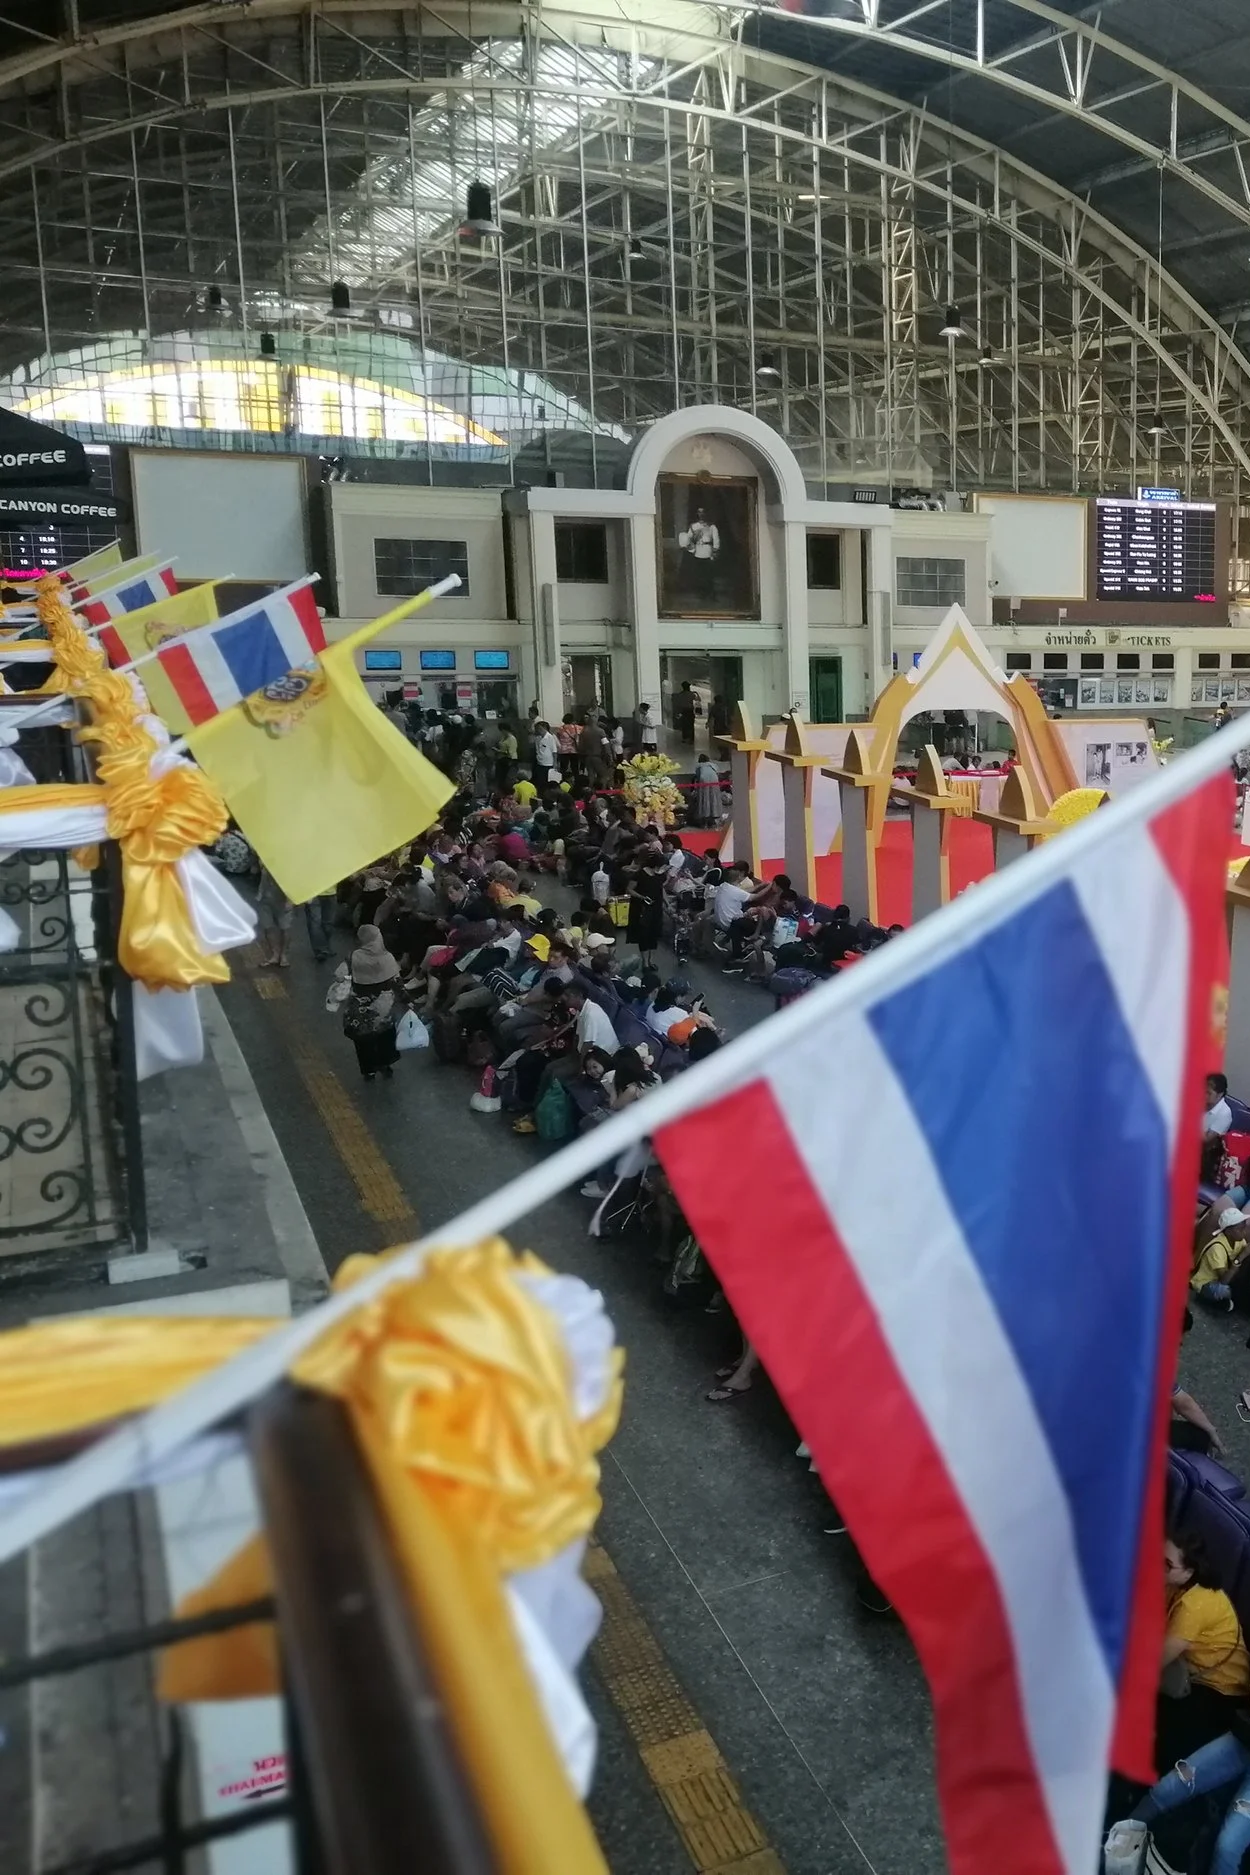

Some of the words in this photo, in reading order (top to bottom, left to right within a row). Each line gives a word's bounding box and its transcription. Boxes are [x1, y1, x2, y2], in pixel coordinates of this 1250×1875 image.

[0, 499, 57, 514] CANYON
[61, 503, 117, 517] COFFEE
[1129, 636, 1172, 647] TICKETS
